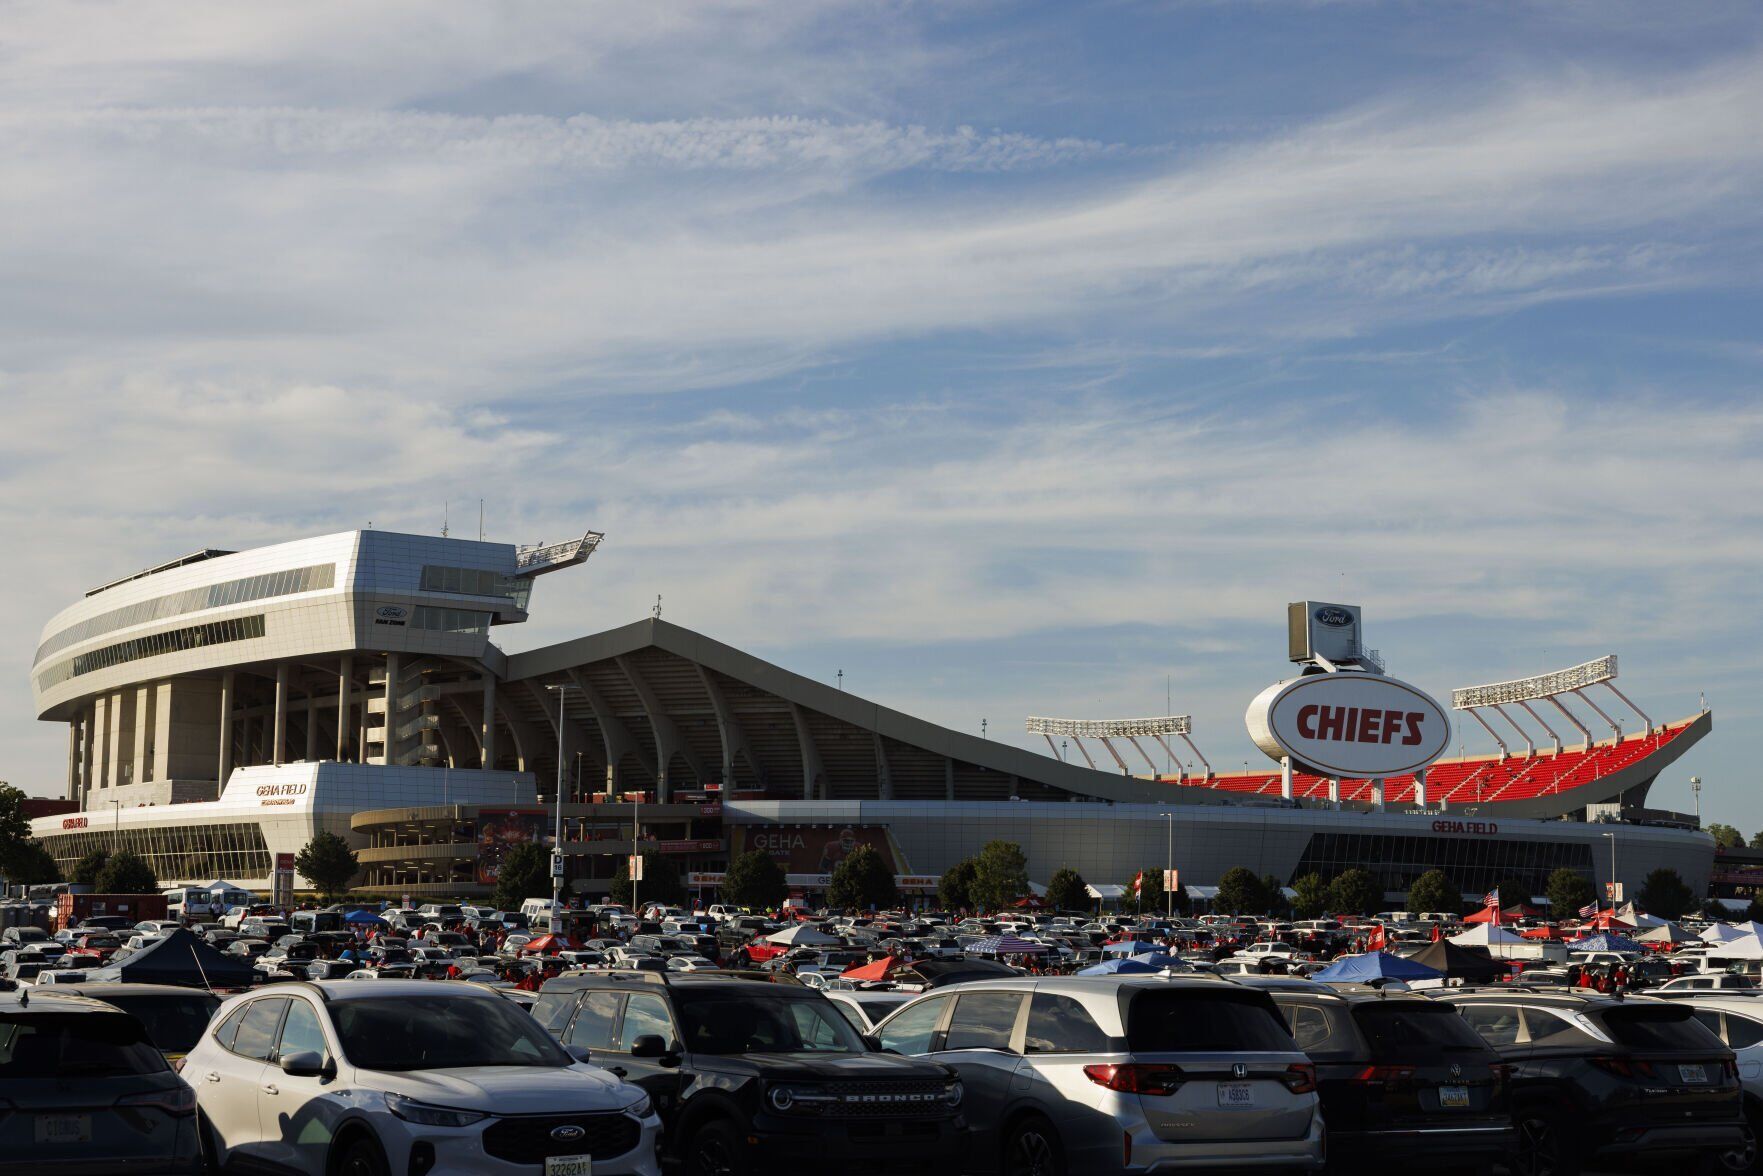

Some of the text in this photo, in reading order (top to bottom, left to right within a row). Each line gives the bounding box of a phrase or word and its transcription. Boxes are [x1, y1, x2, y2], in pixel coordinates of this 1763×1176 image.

[383, 608, 402, 617] Ford
[1321, 610, 1346, 624] Ford
[1297, 704, 1425, 746] CHIEFS
[257, 784, 306, 797] GEHA FIELD
[1432, 821, 1497, 835] GEHA FIELD
[754, 833, 805, 849] GEHA
[555, 855, 562, 864] D
[818, 876, 832, 885] GE
